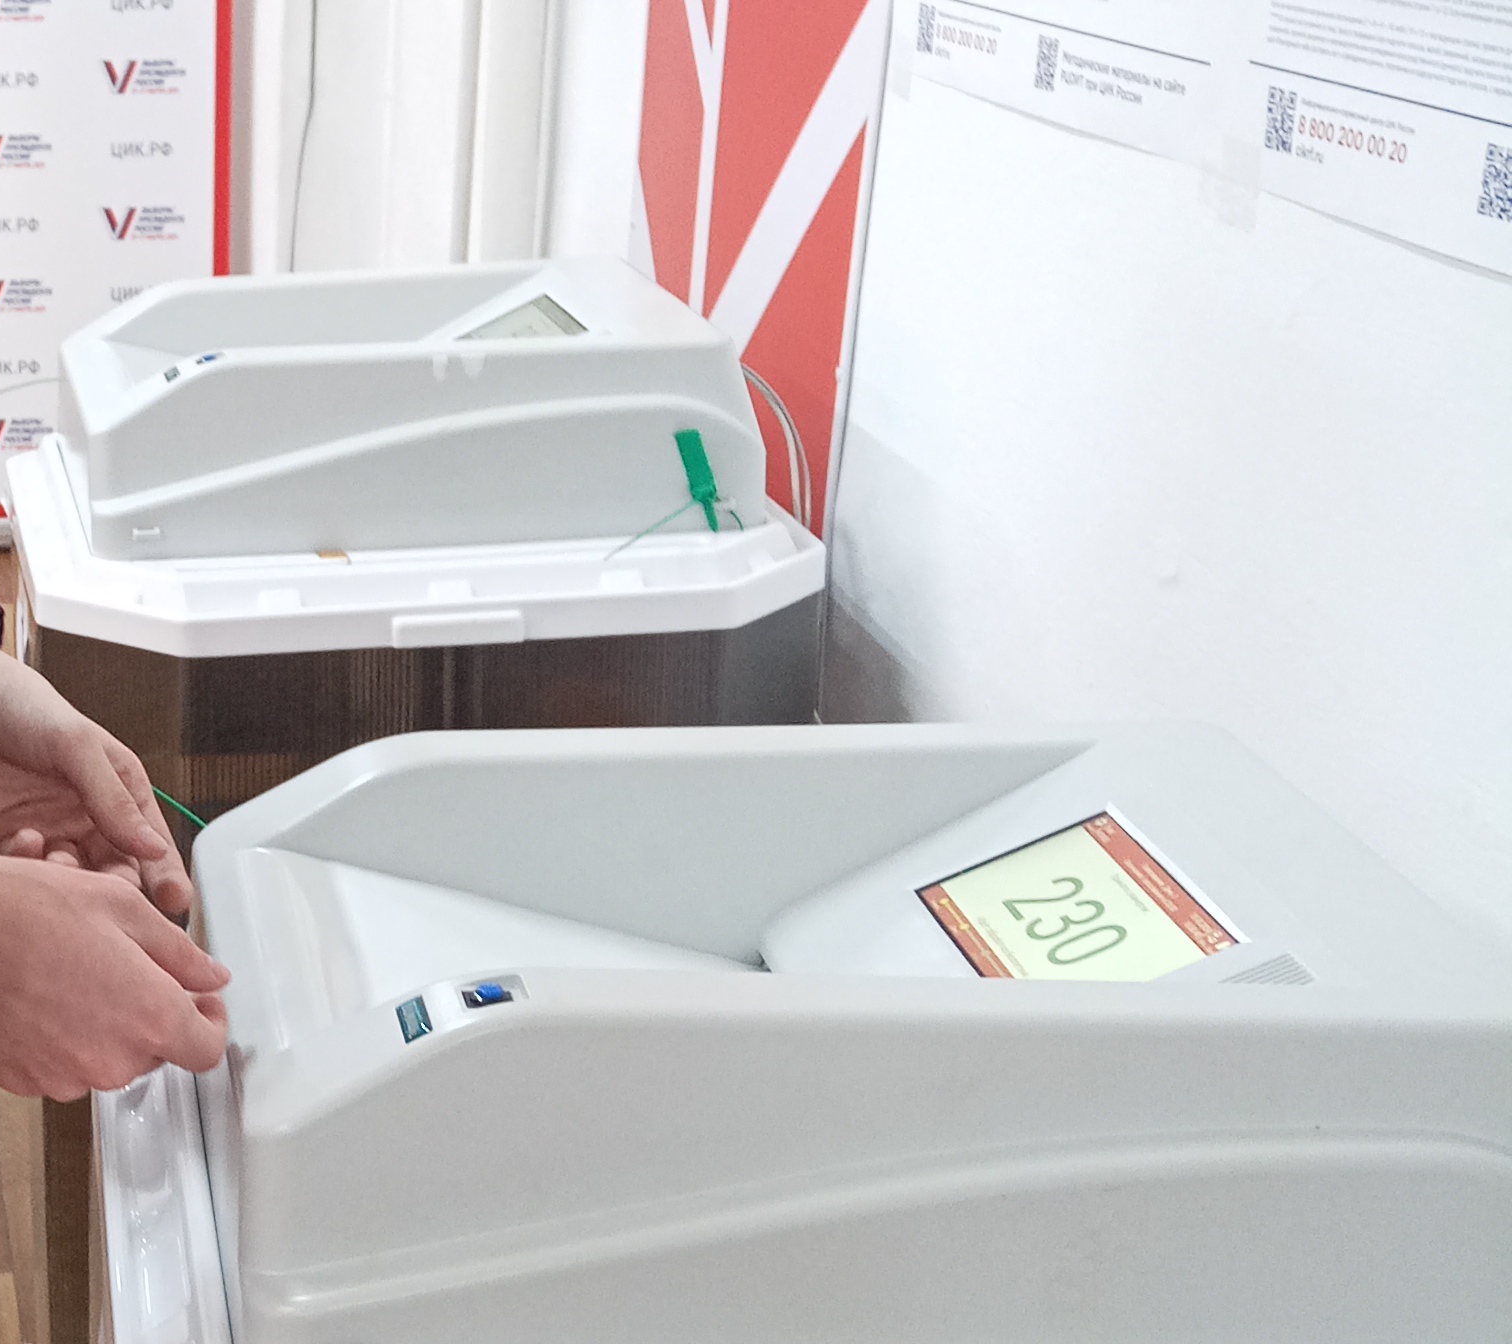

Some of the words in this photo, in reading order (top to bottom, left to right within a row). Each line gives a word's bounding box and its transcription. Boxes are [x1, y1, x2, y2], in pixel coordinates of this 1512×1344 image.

[1297, 114, 1307, 136] 8
[1308, 117, 1335, 144] 800
[1337, 125, 1364, 151] 200
[1366, 134, 1387, 158] 00
[1388, 140, 1408, 164] 20
[1001, 875, 1128, 967] 230
